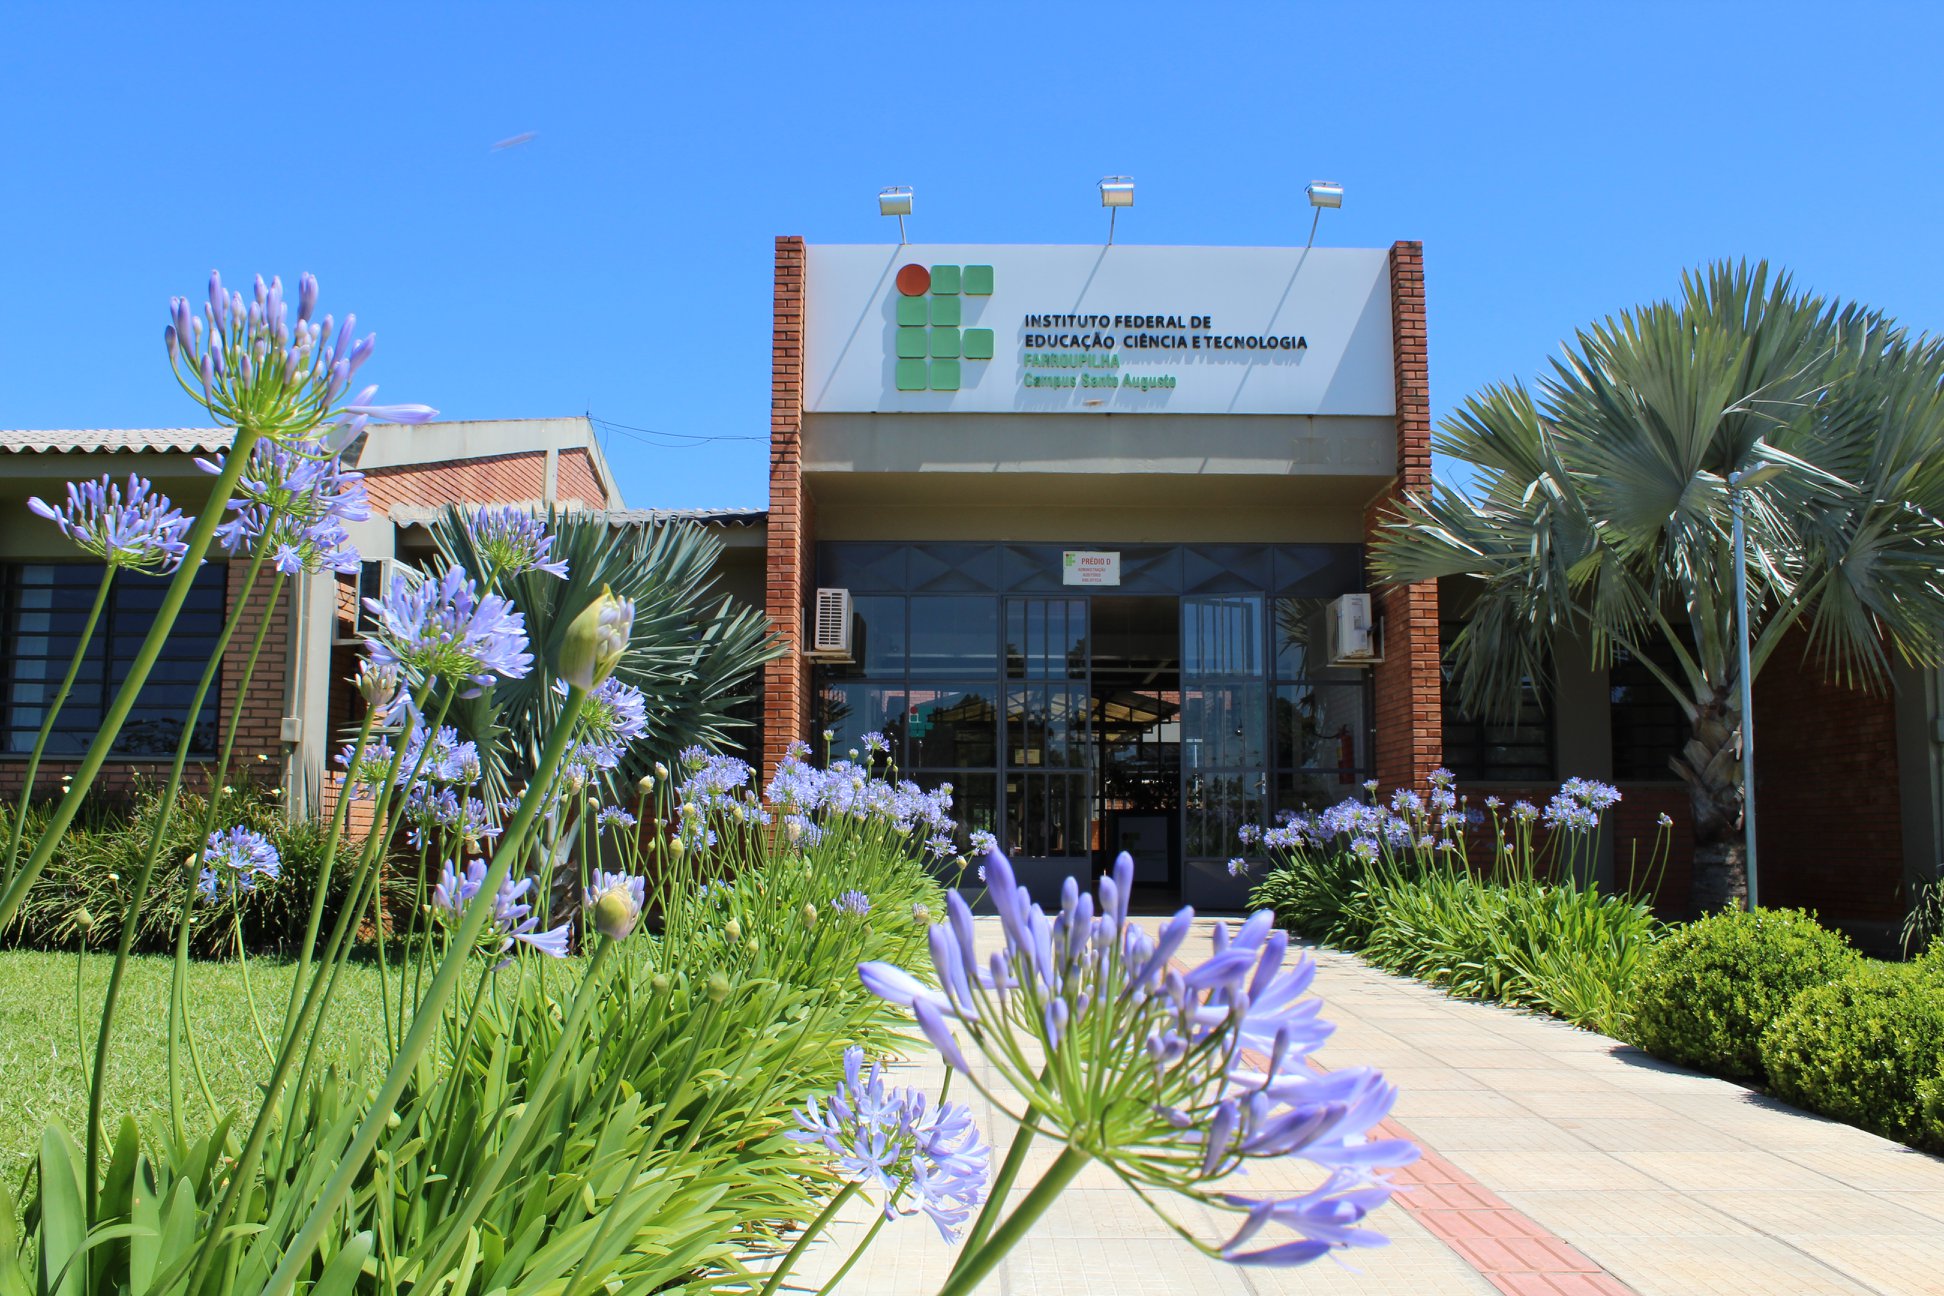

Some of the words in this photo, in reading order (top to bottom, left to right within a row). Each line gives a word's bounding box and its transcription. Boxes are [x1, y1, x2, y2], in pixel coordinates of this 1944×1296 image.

[1025, 314, 1110, 328] INSTITUTO
[1114, 315, 1186, 329] FEDERAL
[1190, 315, 1211, 329] DE
[1025, 331, 1115, 351] EDUCAÇÃO
[1123, 333, 1188, 349] CIÊNCIA
[1192, 335, 1201, 349] E
[1203, 335, 1308, 350] TECNOLOGIA
[1024, 353, 1120, 368] FARROUPILHA
[1024, 373, 1077, 390] Campus
[1081, 373, 1119, 388] Santo
[1122, 373, 1177, 392] Augusto
[1081, 557, 1105, 565] PRÉDIO
